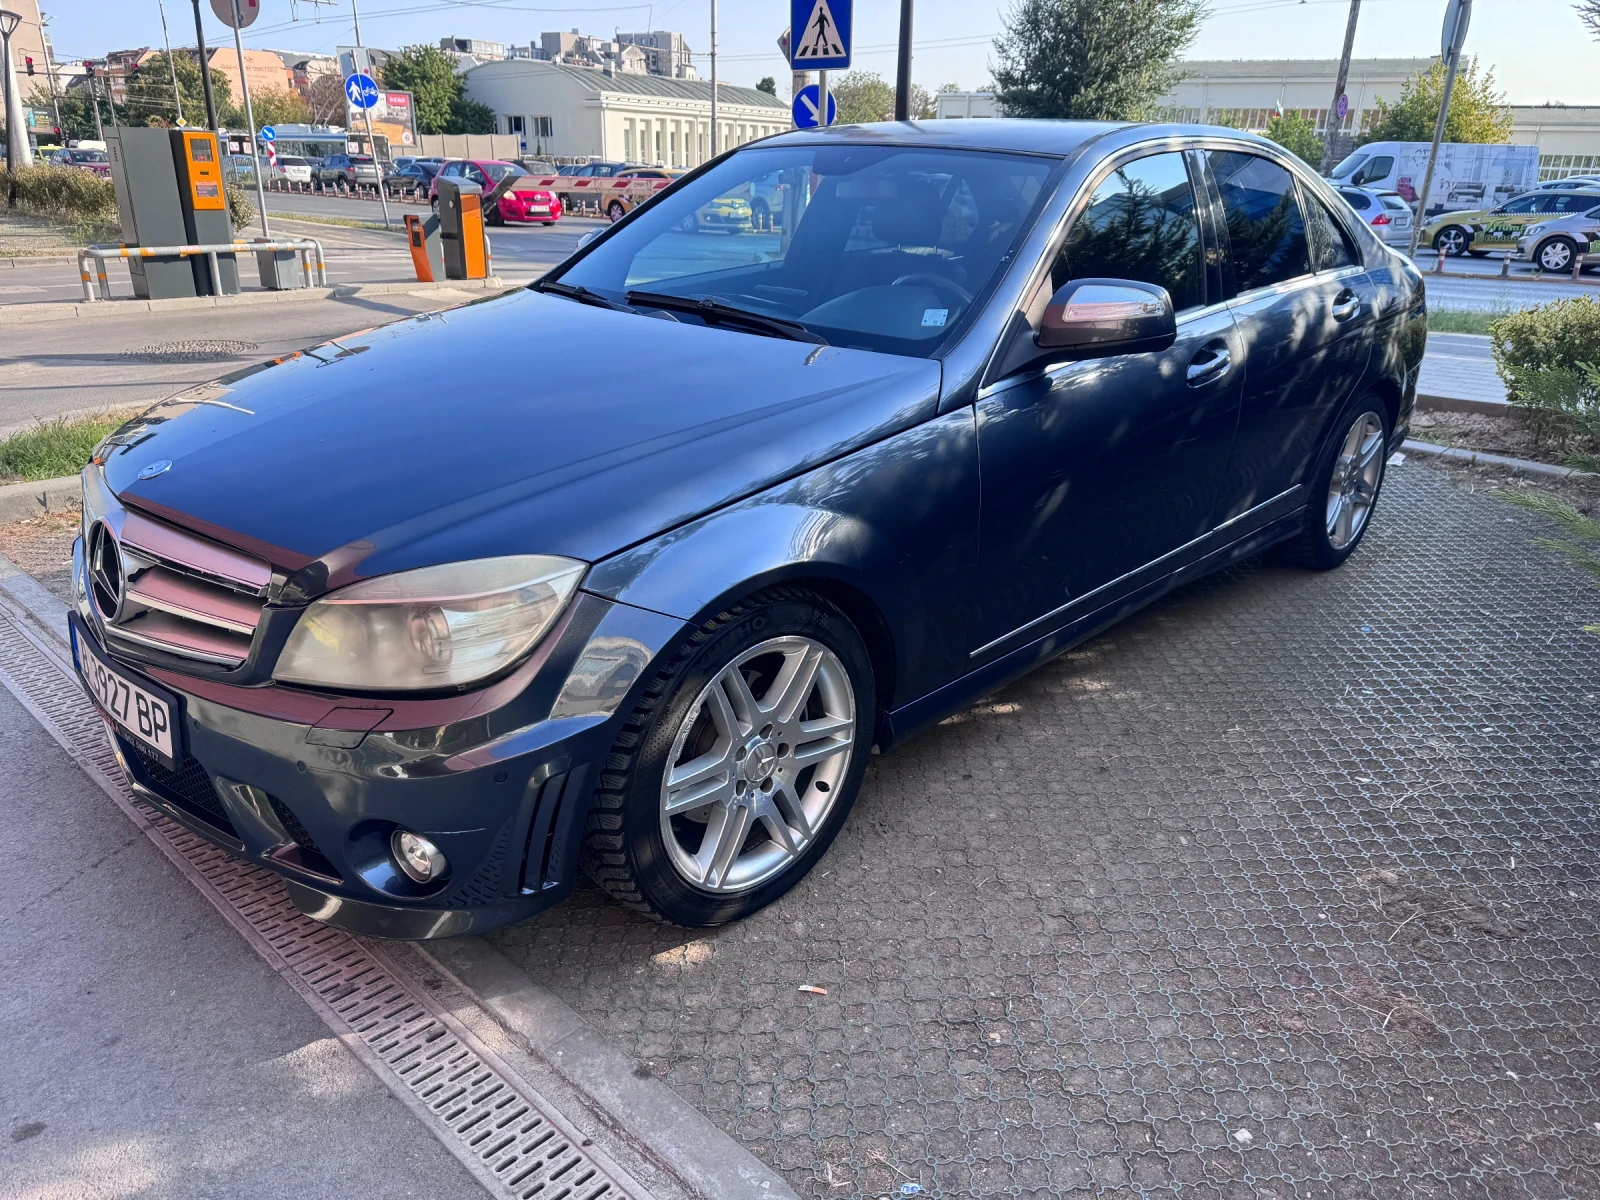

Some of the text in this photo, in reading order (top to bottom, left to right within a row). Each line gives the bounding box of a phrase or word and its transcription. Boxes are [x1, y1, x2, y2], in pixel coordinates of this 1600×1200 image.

[80, 634, 90, 681] B
[90, 654, 130, 722] 3927
[135, 690, 167, 744] BP
